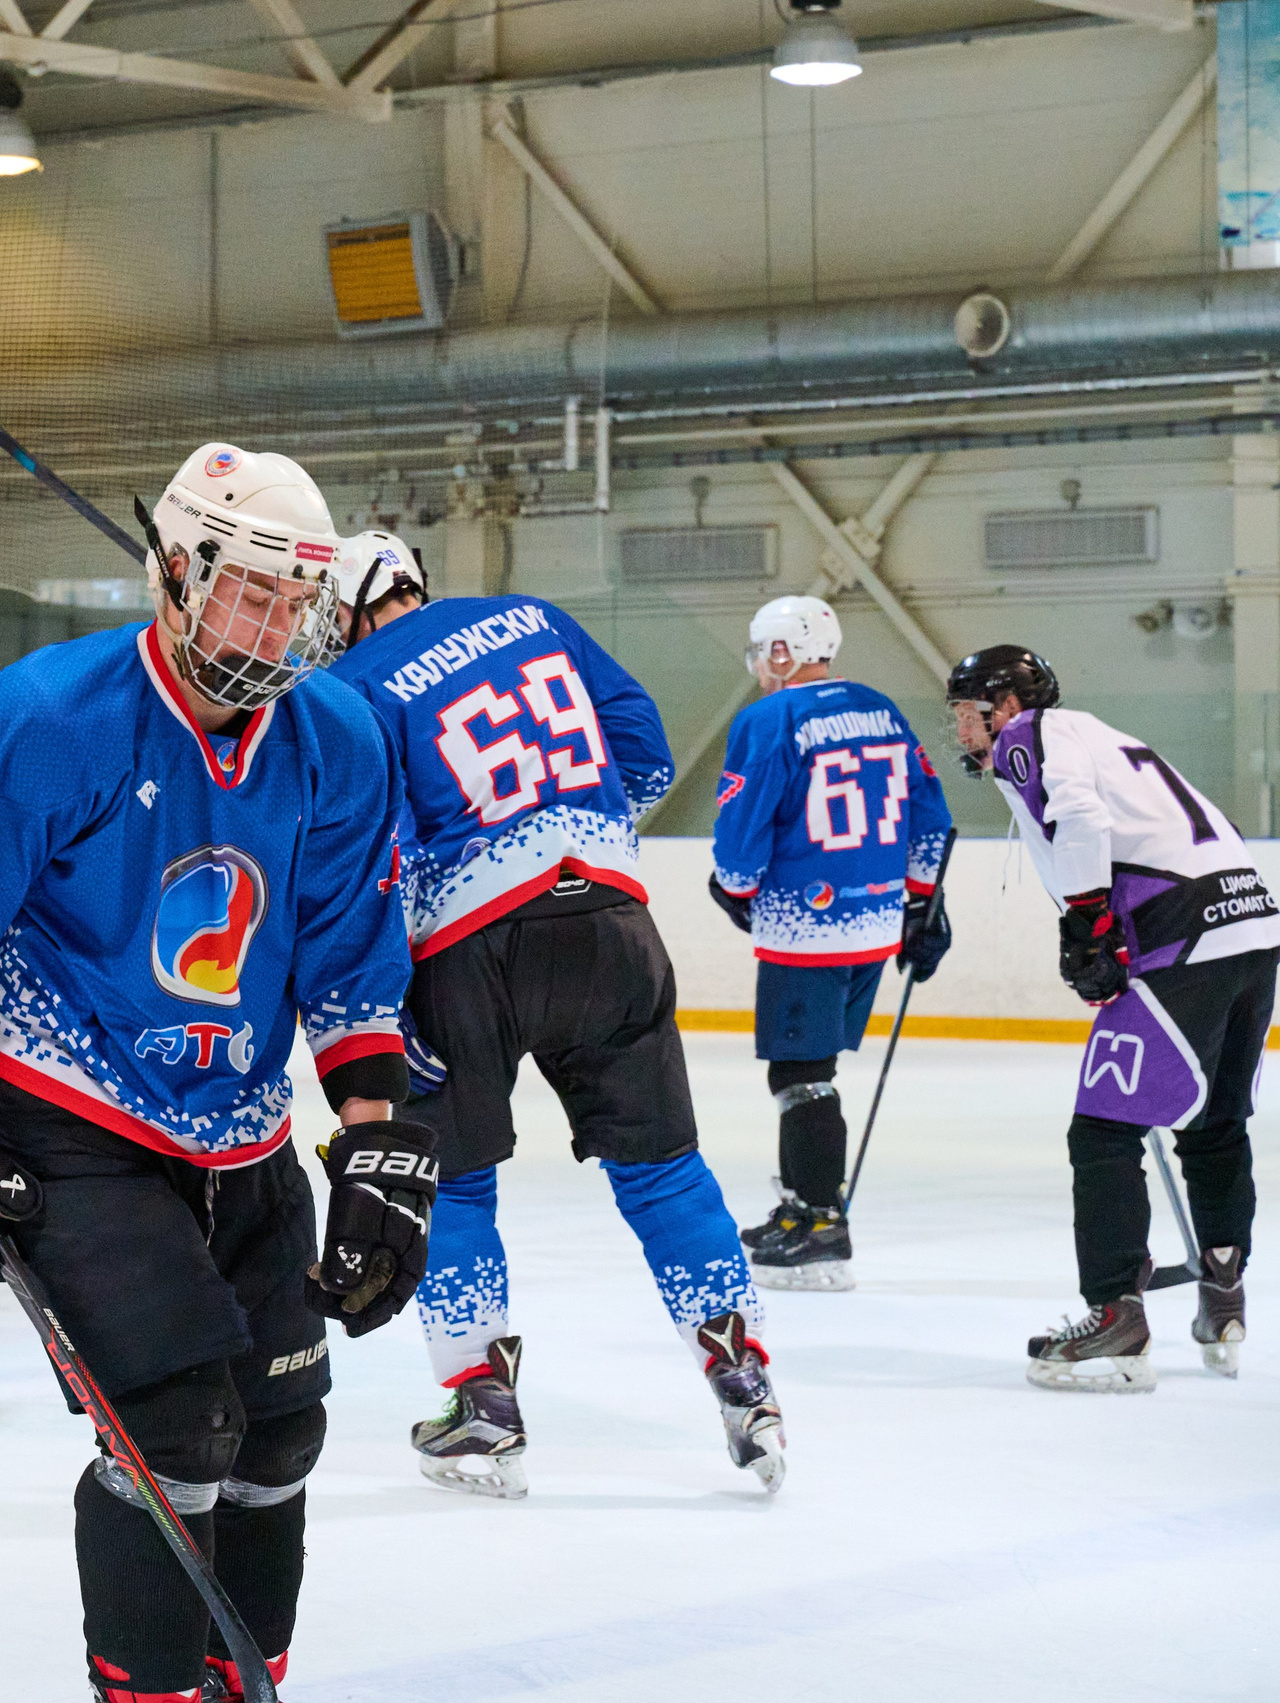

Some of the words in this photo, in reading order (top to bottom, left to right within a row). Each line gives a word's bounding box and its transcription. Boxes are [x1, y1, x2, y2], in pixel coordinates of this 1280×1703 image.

[376, 549, 401, 567] 69
[383, 603, 559, 703] КАЛУЖСКИ
[433, 650, 609, 828] 69
[805, 742, 910, 853] 67
[343, 1150, 440, 1186] BAU
